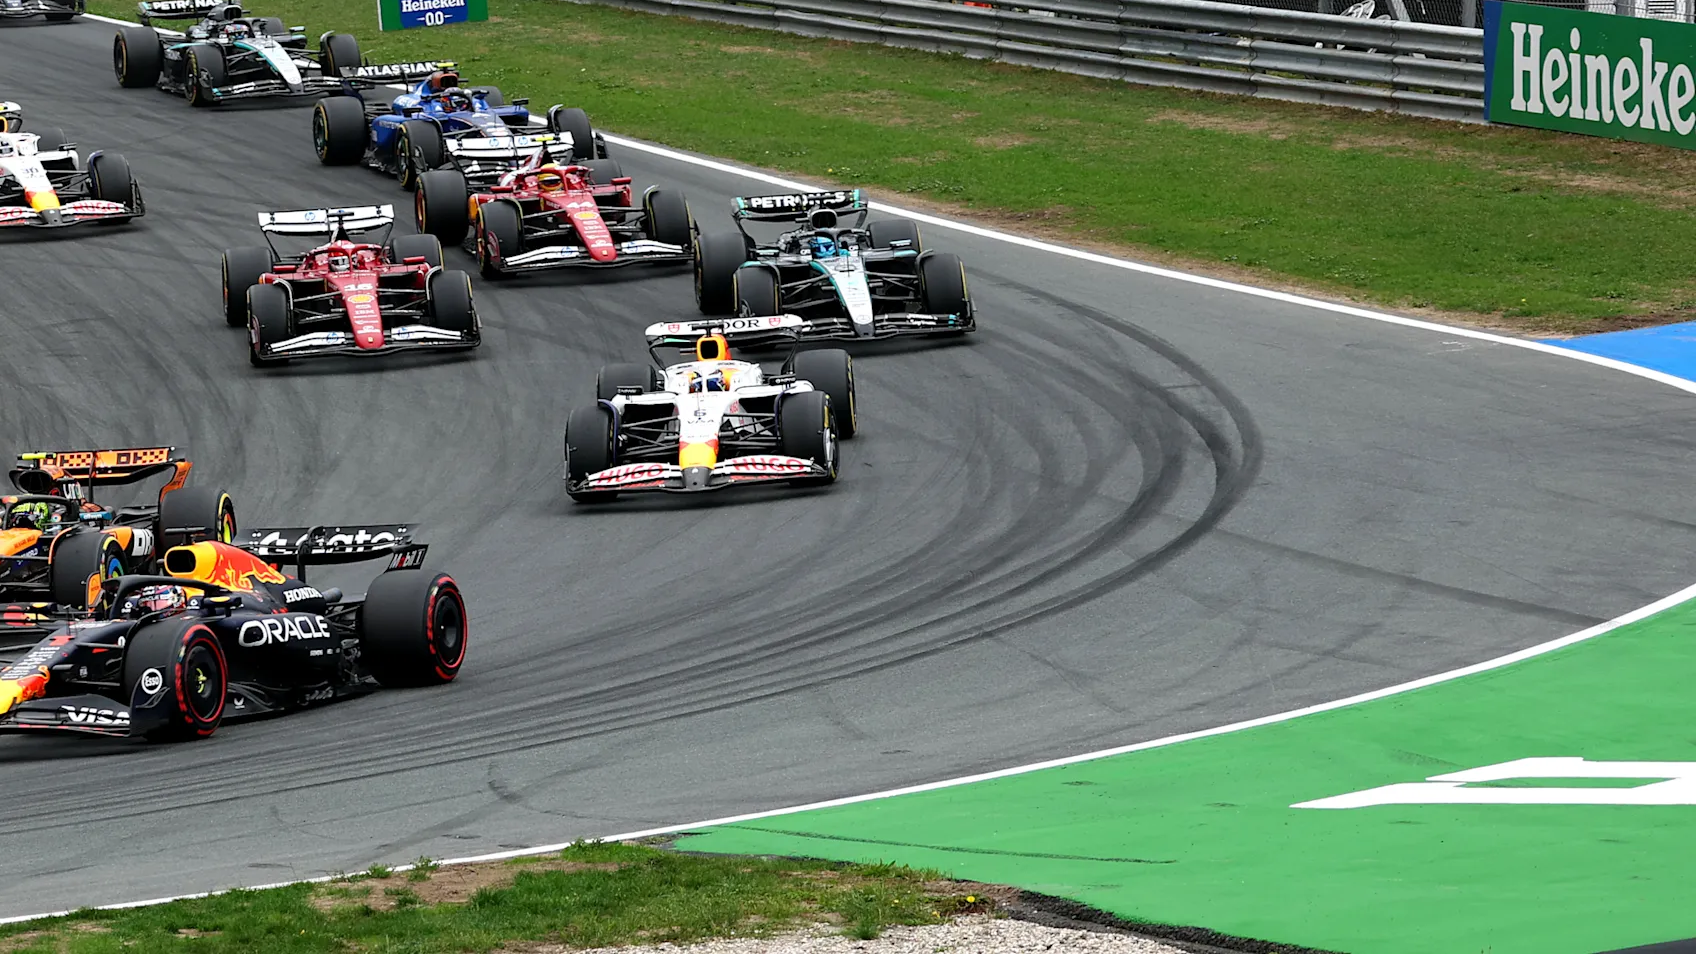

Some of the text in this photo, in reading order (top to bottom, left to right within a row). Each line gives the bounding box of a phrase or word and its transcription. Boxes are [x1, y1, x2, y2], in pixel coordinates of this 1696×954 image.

[425, 11, 444, 27] 0.0
[355, 61, 438, 77] ATLASSIAN
[1510, 21, 1696, 135] Heineke
[596, 462, 664, 484] HUGO
[732, 456, 805, 472] HUGO
[389, 550, 414, 569] Mobil
[283, 586, 323, 604] HONDA
[238, 615, 331, 648] ORACLE
[144, 675, 161, 687] Esso
[62, 705, 131, 725] VISA
